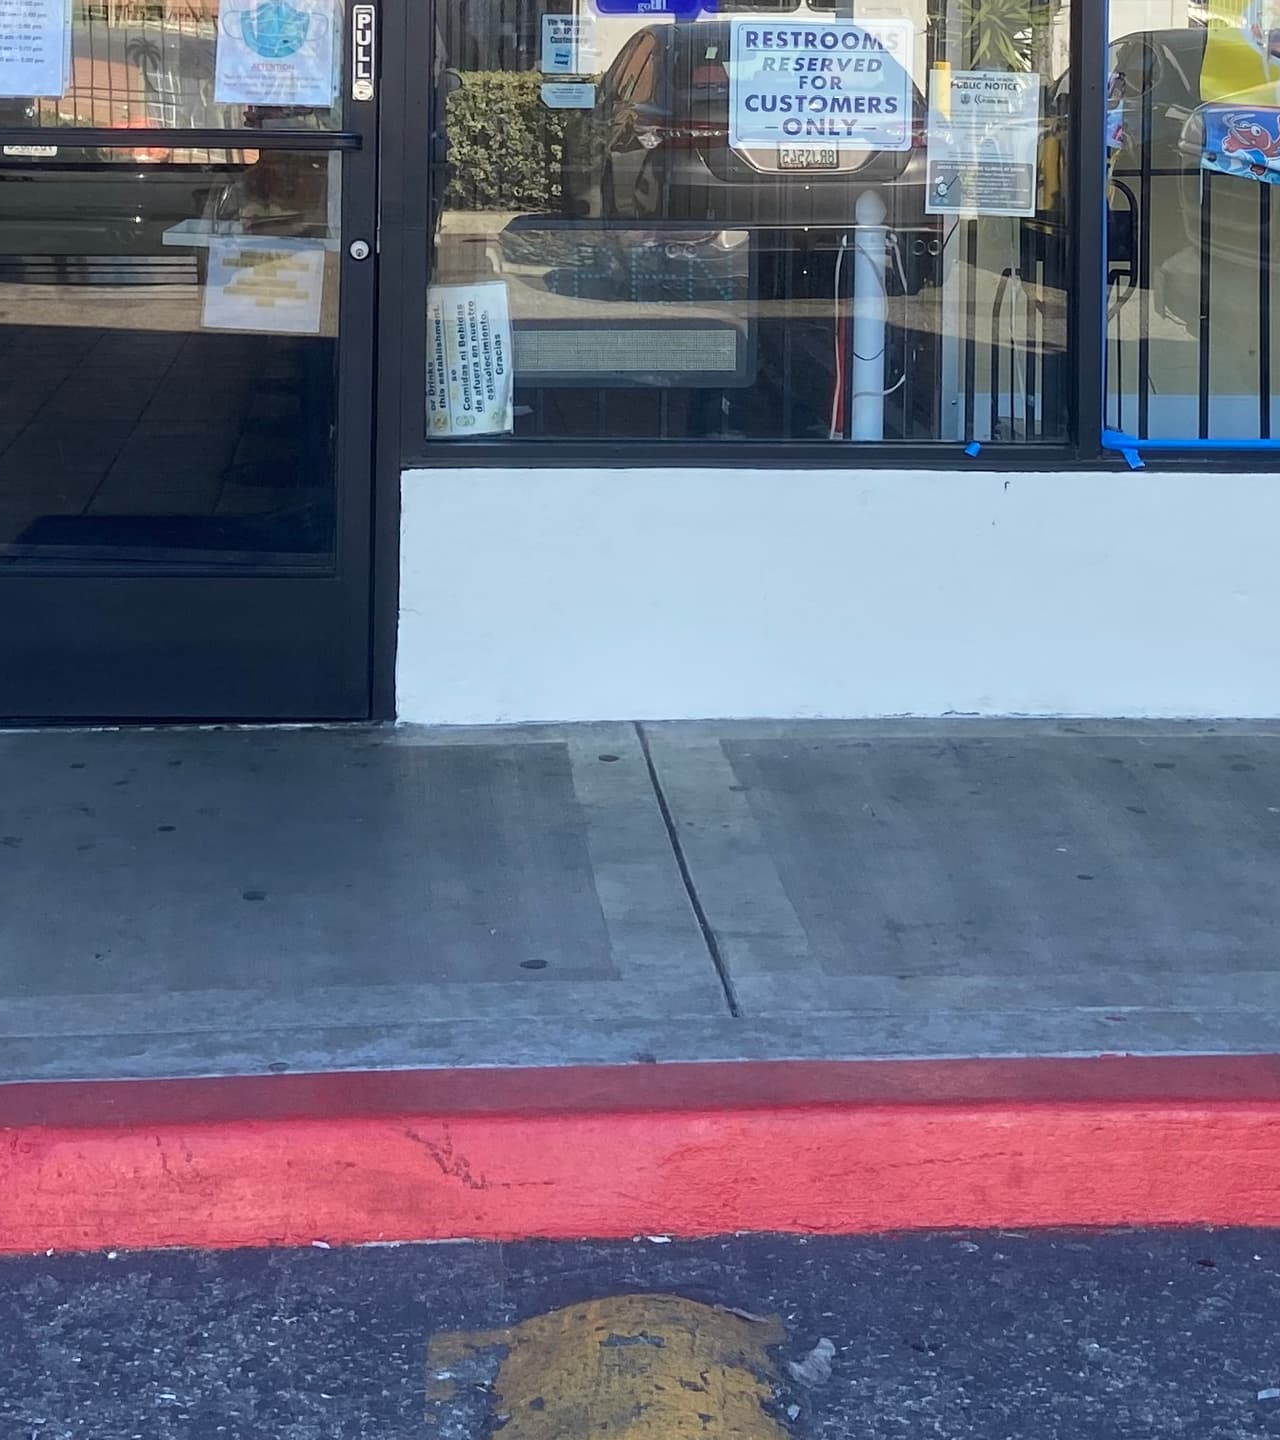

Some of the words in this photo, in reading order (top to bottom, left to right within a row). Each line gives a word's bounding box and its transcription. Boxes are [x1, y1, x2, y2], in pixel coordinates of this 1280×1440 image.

[356, 13, 371, 78] PULL
[745, 31, 899, 50] RESTROOMS
[762, 56, 883, 72] RESERVED
[798, 75, 843, 90] FOR
[744, 94, 899, 114] CUSTOMERS
[782, 117, 858, 137] ONLY
[494, 333, 504, 376] Gracias
[461, 363, 471, 411] Comidas
